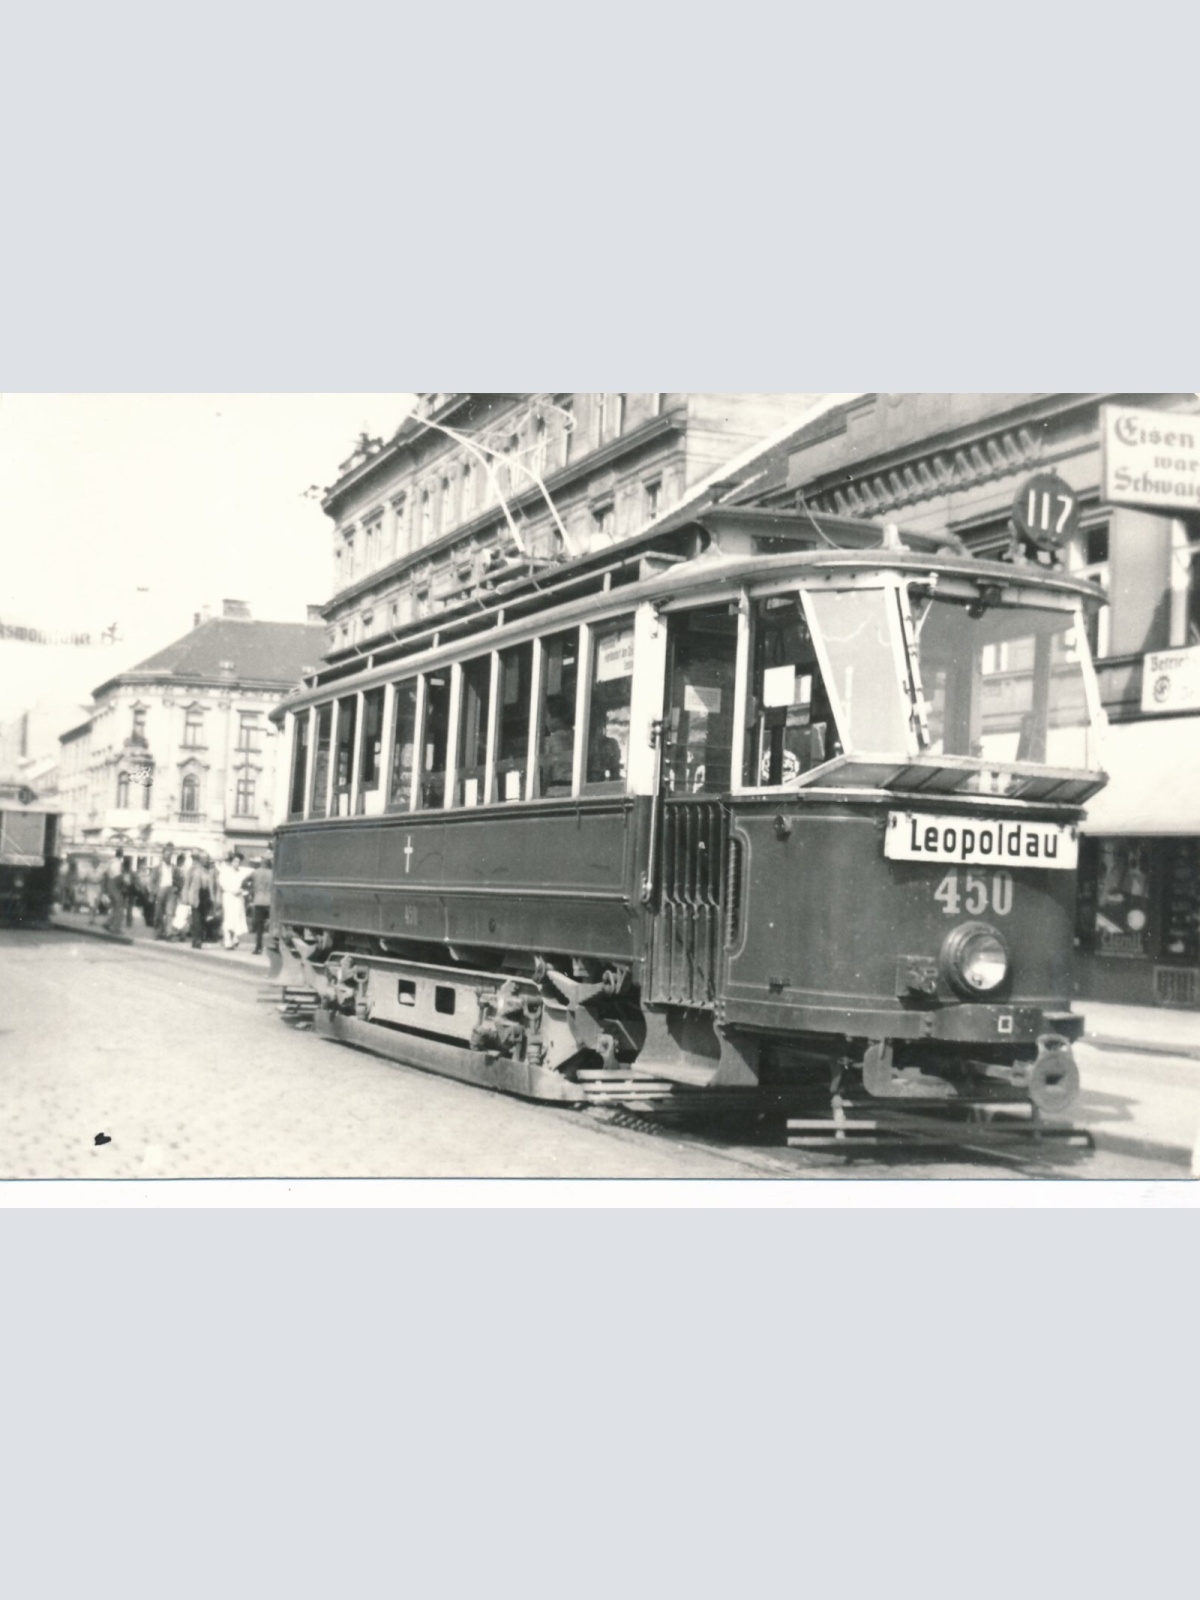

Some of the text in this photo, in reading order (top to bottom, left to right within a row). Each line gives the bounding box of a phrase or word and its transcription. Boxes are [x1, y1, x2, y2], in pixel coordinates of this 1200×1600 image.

[1114, 415, 1195, 449] Eisen
[1027, 488, 1073, 534] 117
[910, 818, 1058, 860] Leopoldau
[933, 867, 1013, 916] 450
